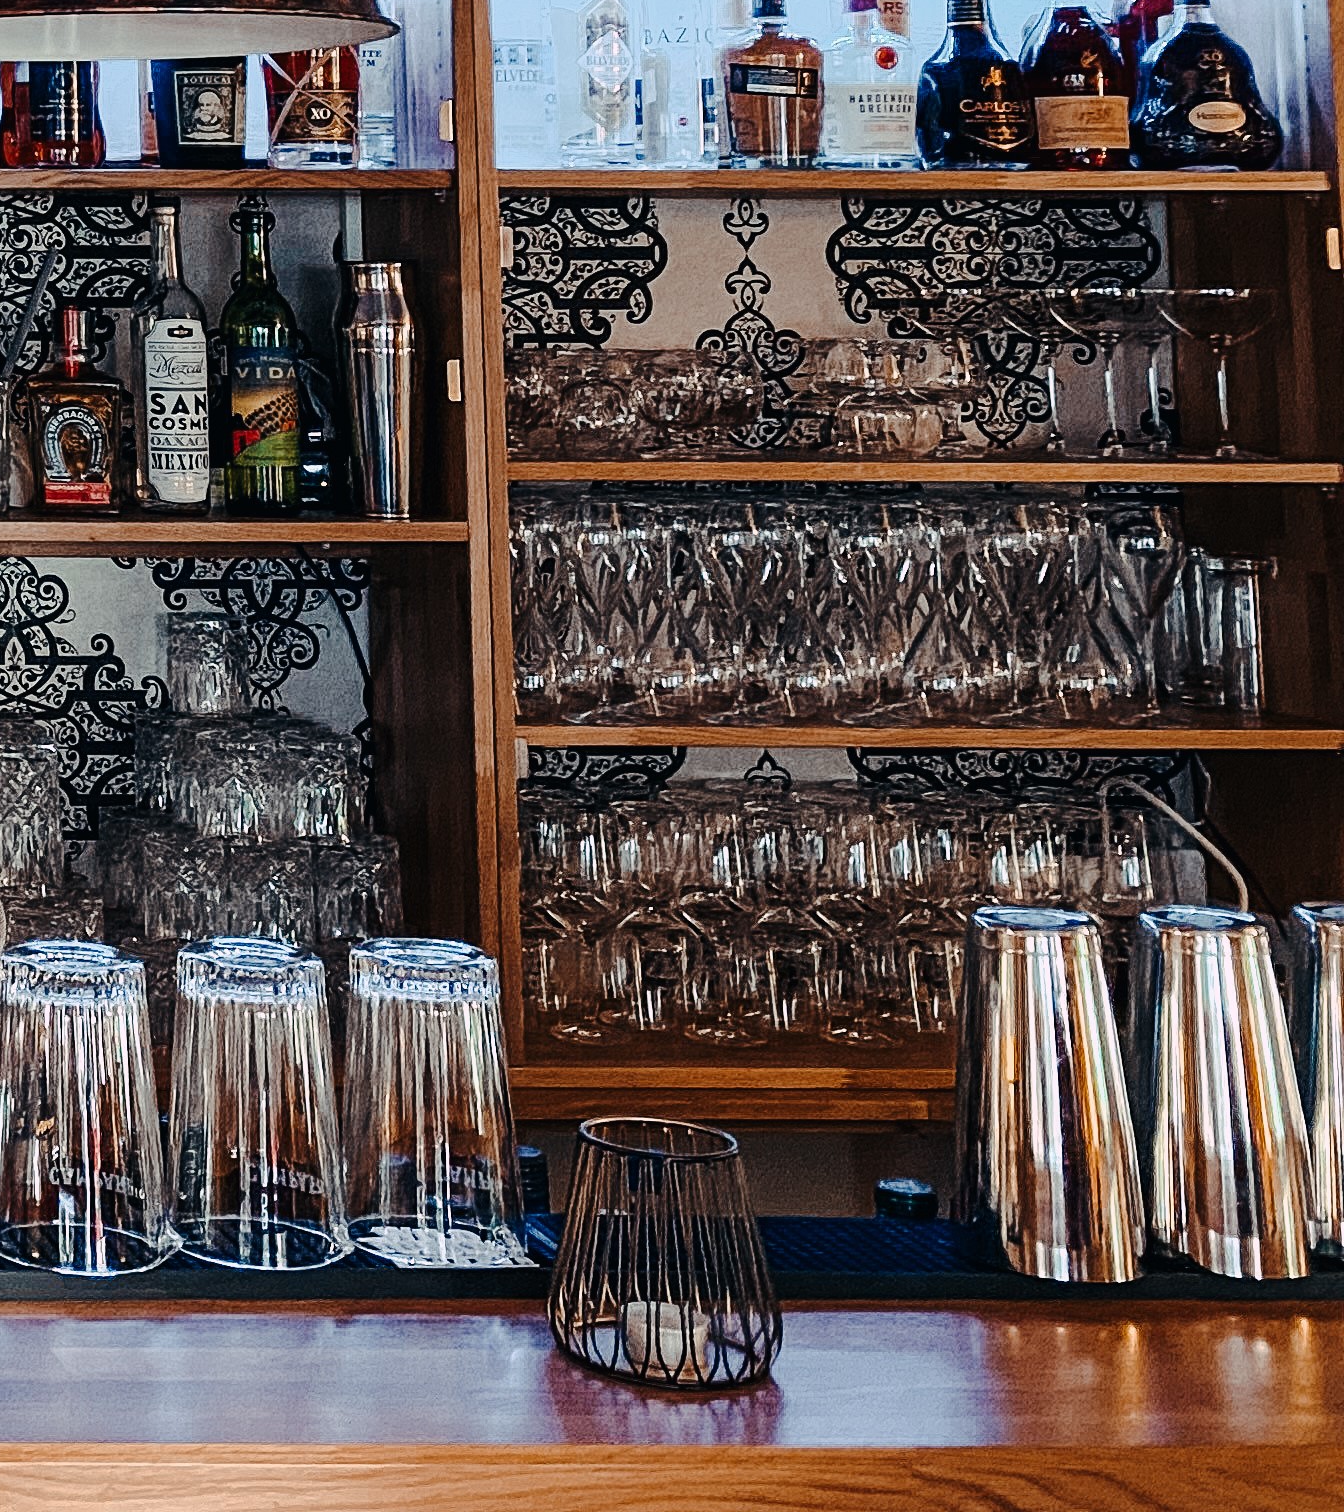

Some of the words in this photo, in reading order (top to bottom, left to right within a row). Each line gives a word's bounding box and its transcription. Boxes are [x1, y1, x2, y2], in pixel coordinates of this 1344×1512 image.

[310, 107, 331, 120] XO
[960, 100, 1018, 113] CARLOS
[149, 354, 204, 380] Mezcal
[235, 367, 297, 379] VIDA
[150, 393, 207, 415] SAN
[49, 411, 99, 433] HERRADURA
[149, 417, 208, 430] COSME
[151, 453, 209, 470] MEXICO
